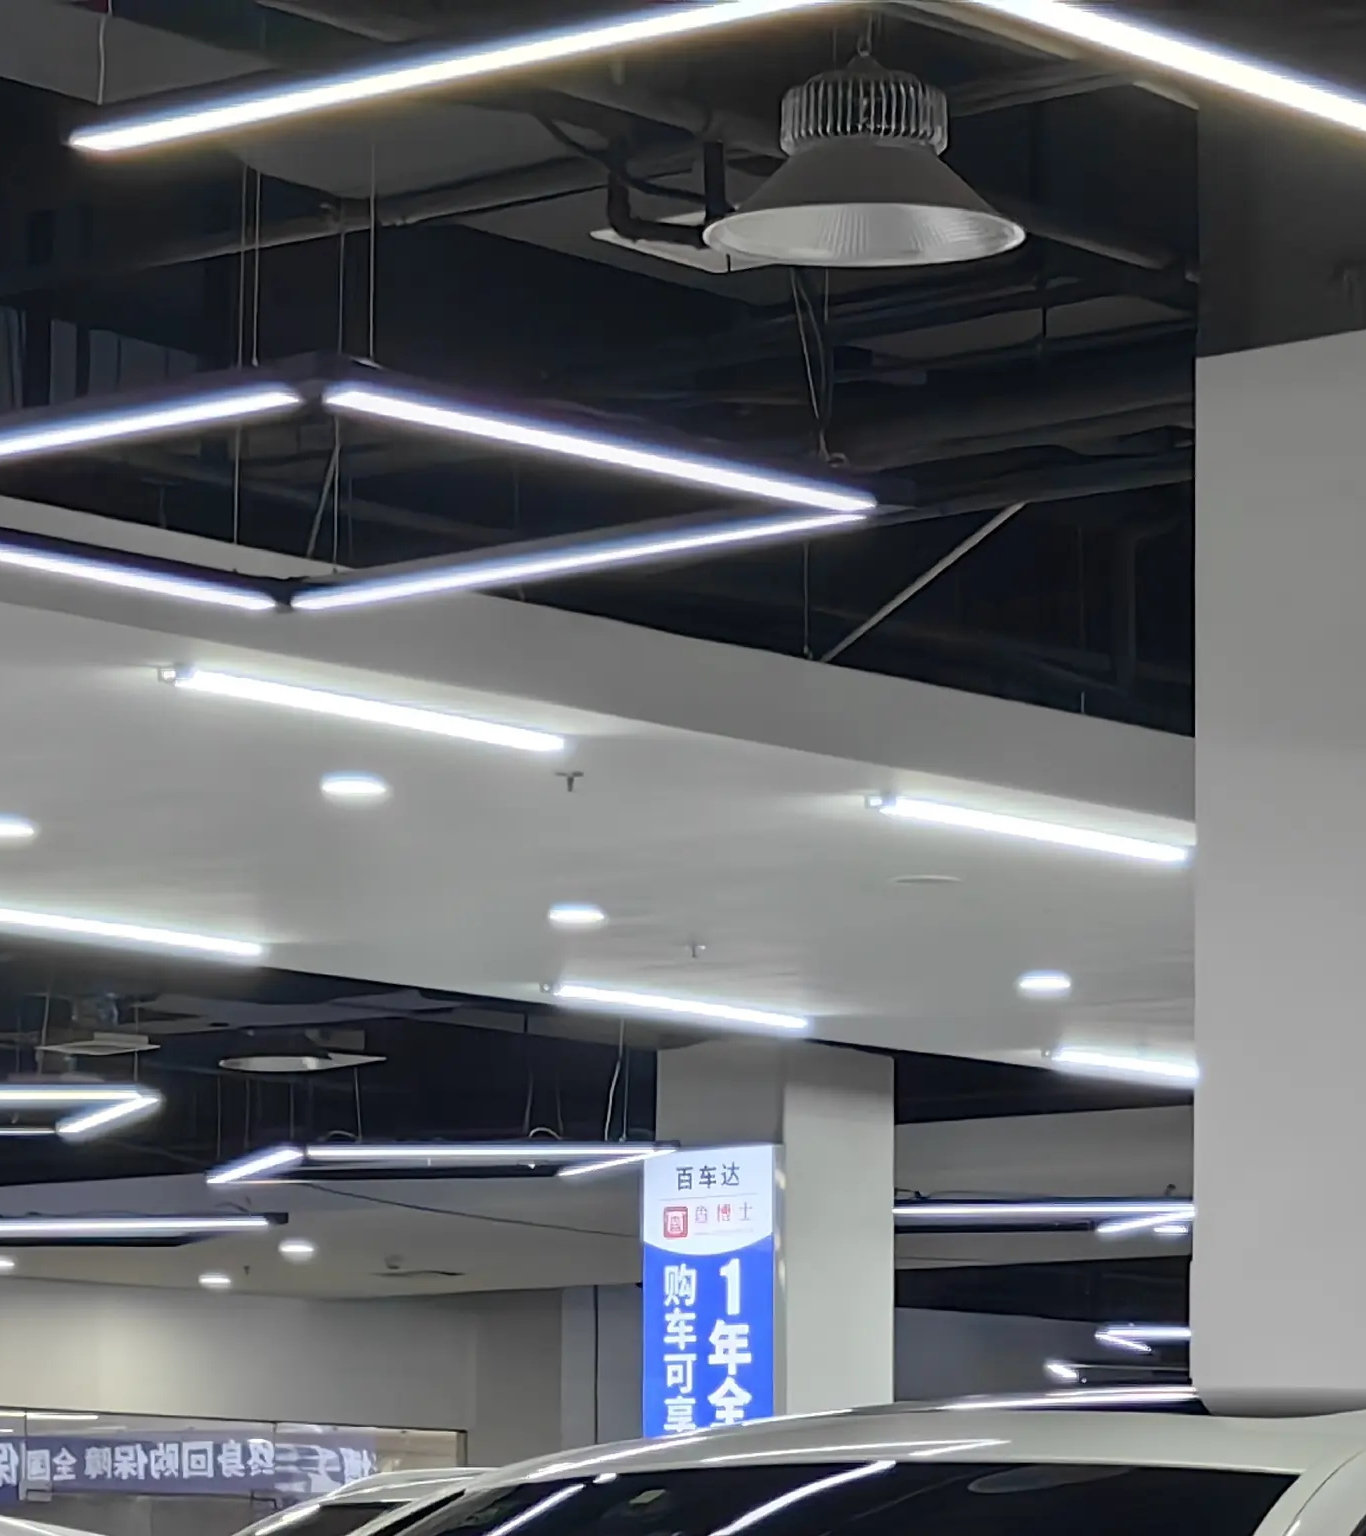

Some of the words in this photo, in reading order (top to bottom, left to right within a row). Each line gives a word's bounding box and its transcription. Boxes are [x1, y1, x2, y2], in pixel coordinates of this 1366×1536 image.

[675, 1161, 741, 1191] 百车达
[663, 1263, 697, 1432] 购车可享
